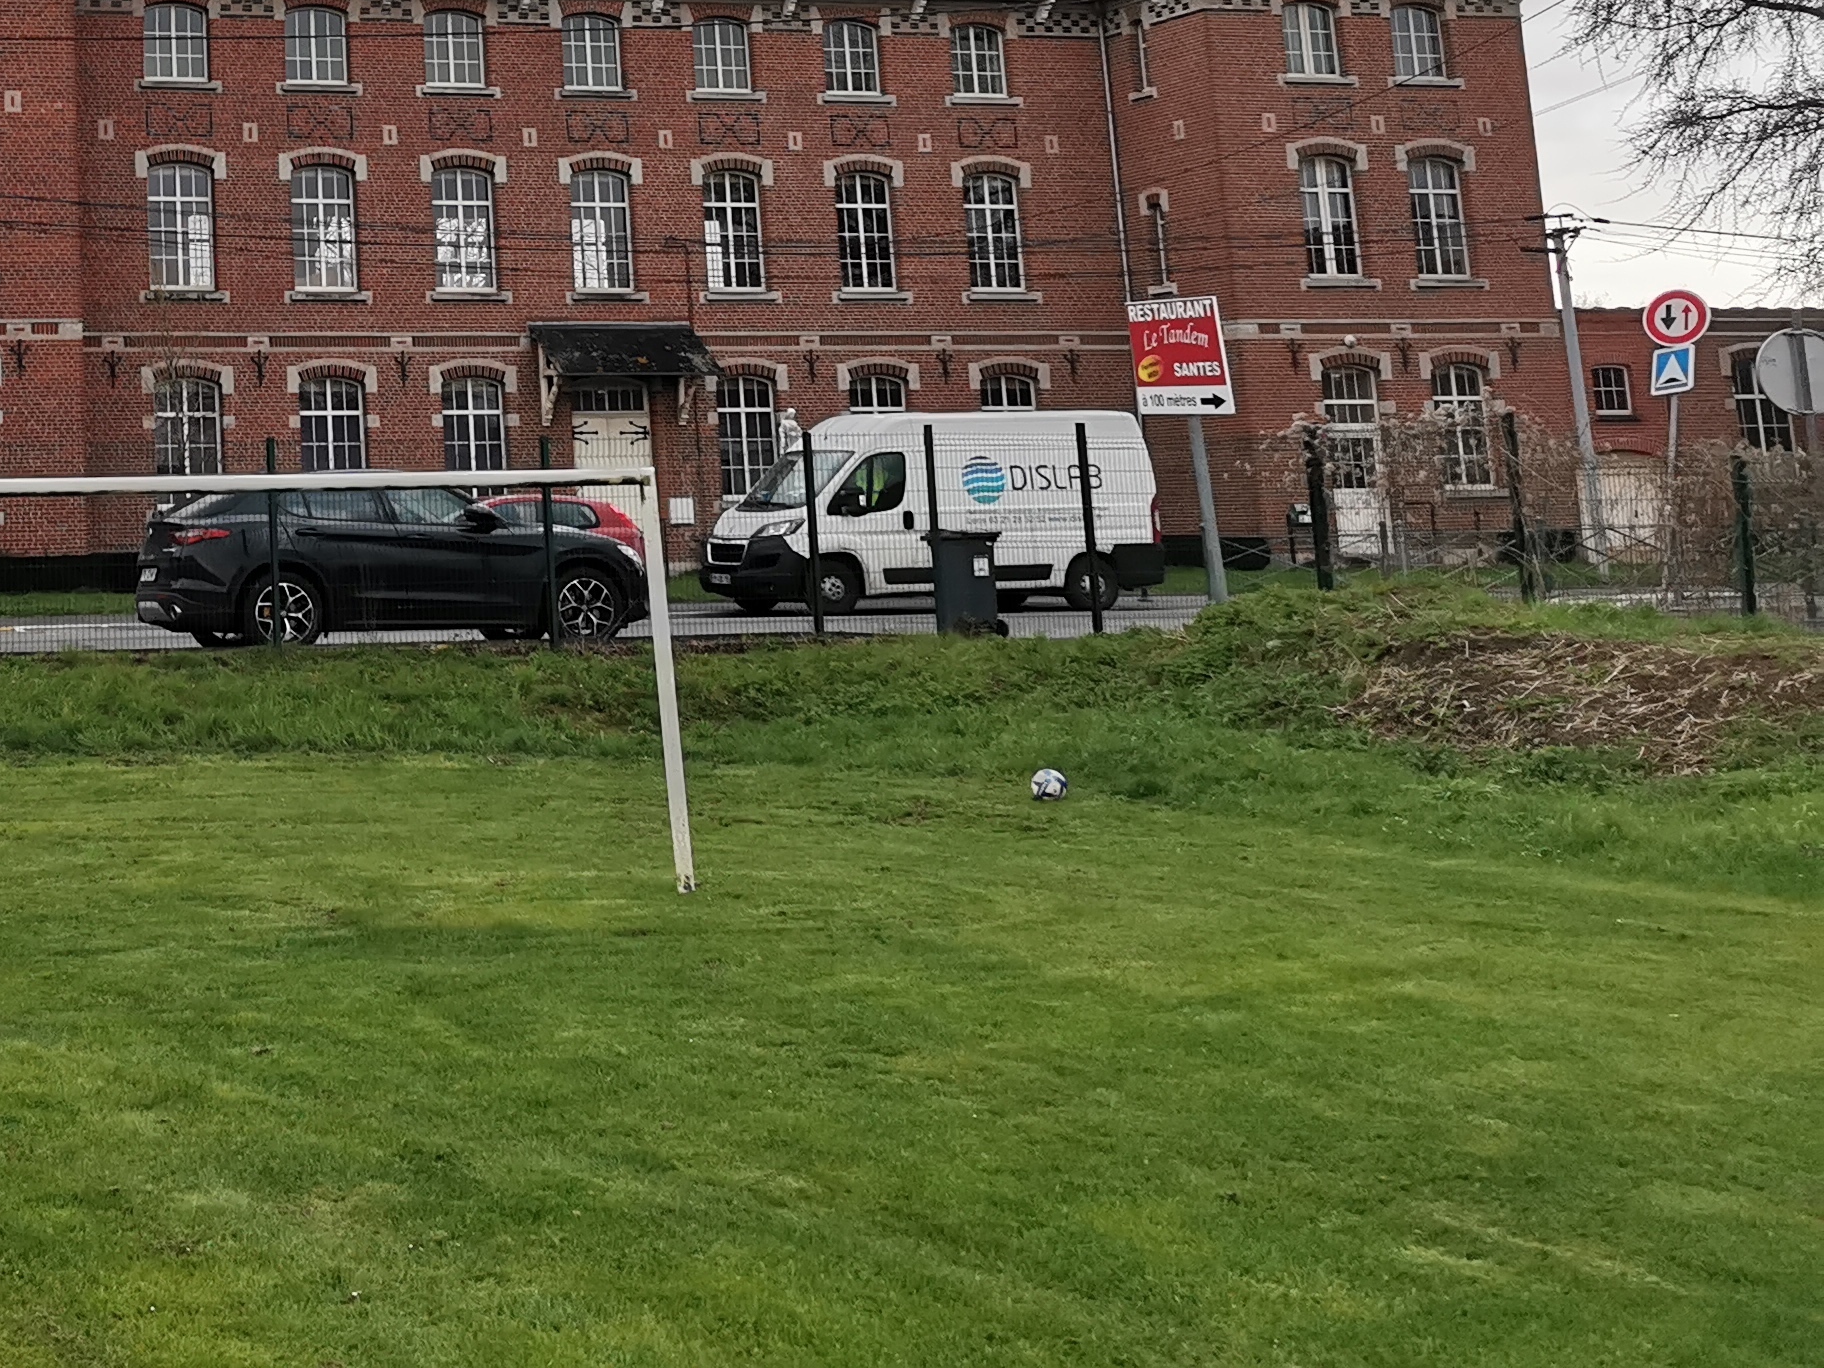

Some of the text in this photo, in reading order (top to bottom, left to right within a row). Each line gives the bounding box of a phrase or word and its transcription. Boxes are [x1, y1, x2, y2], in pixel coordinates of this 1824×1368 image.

[1127, 299, 1212, 322] RESTAURANT
[1143, 322, 1209, 351] Le Tandem
[1173, 361, 1221, 377] SANTES
[1142, 392, 1197, 407] à 100 mètres
[1009, 464, 1103, 491] DISLAB
